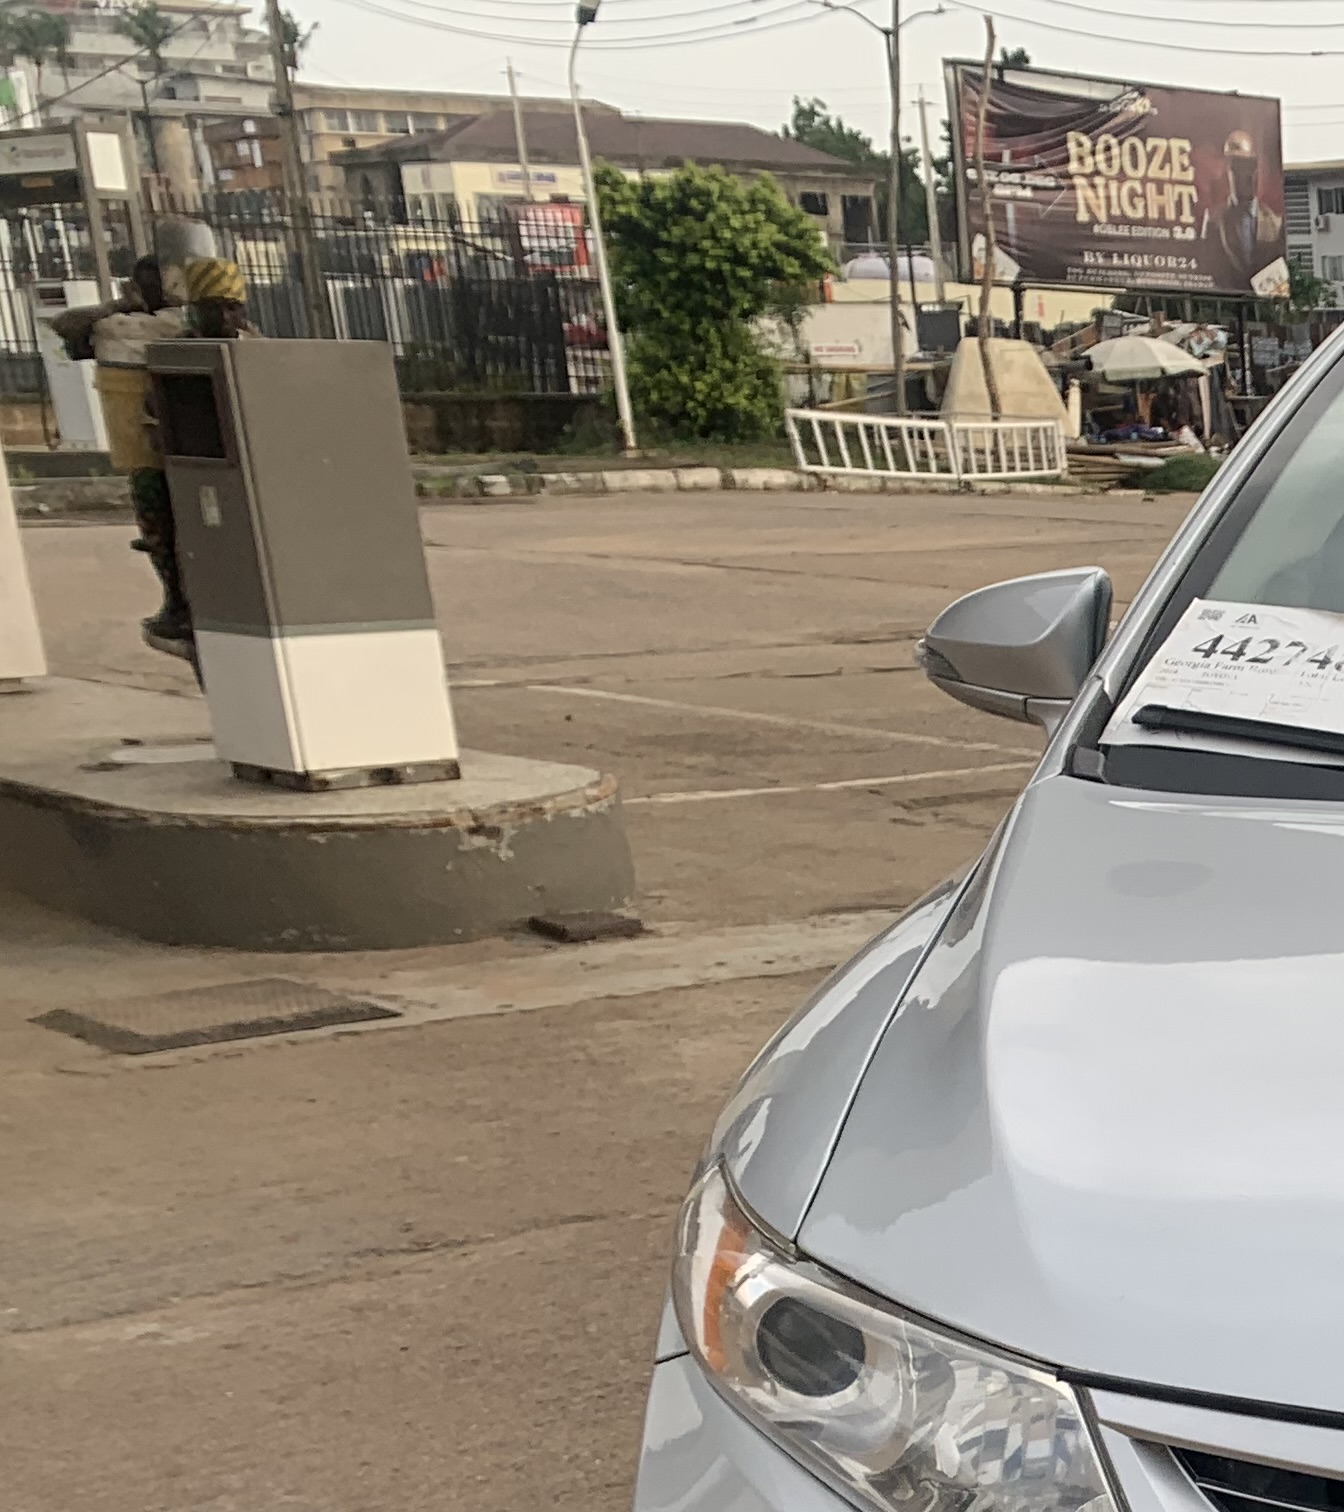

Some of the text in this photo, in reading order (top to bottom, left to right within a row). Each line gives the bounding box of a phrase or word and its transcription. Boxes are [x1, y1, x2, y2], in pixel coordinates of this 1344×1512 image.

[1067, 131, 1195, 182] BOOZE
[1073, 176, 1198, 224] NIGHT
[1131, 225, 1170, 239] EDITION
[1083, 250, 1199, 270] BY LIQUOR24
[1164, 658, 1211, 670] Georgia
[1214, 660, 1244, 671] Farm
